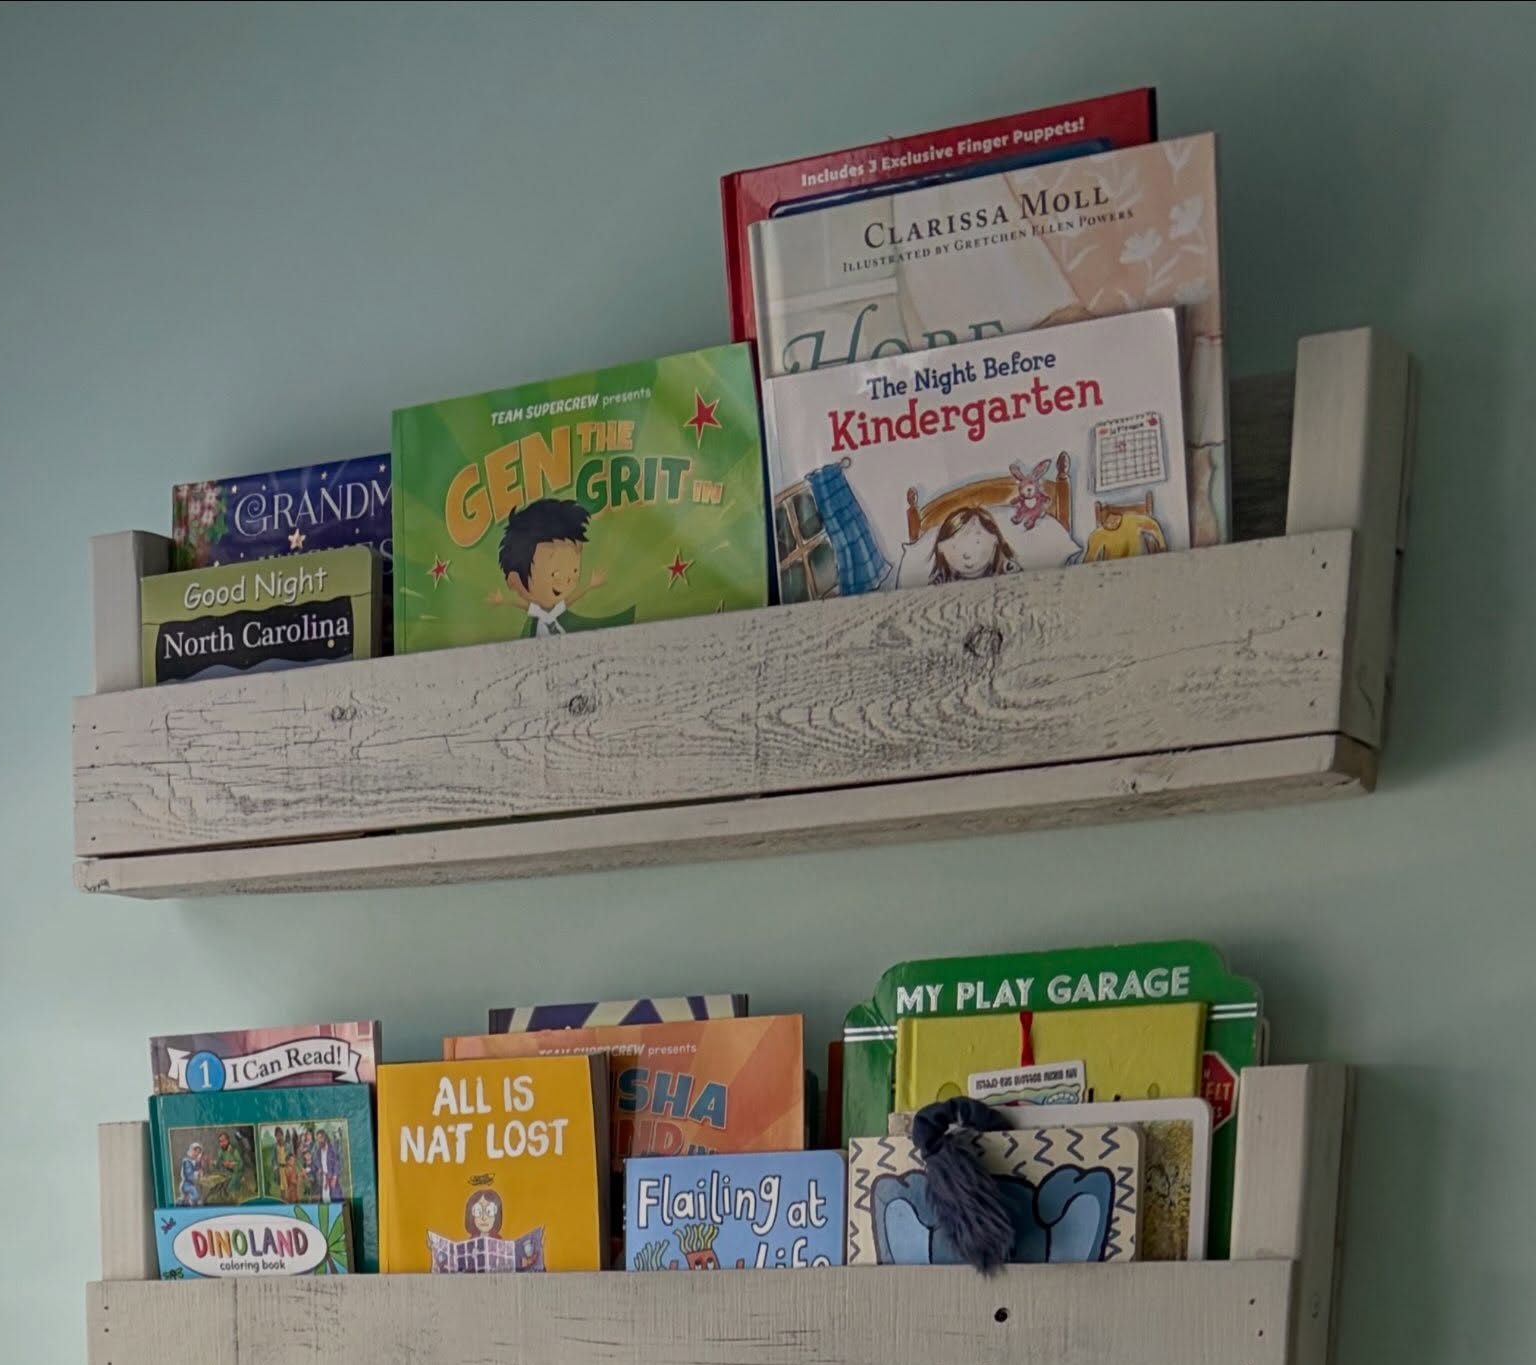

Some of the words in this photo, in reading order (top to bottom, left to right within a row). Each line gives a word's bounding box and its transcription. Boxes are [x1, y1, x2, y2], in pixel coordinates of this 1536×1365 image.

[801, 165, 864, 187] Includes
[869, 161, 877, 175] 3
[881, 146, 953, 171] Exclusive
[957, 135, 1009, 156] Finger
[1012, 117, 1085, 145] Puppets!
[842, 247, 931, 273] ILLUSTRATED
[954, 228, 1026, 251] GRETCHEN
[1031, 220, 1074, 238] ELLEN
[1078, 208, 1134, 227] POWERS
[864, 205, 1009, 248] CLARISSA
[1020, 186, 1109, 219] MOLL
[866, 374, 908, 401] The
[914, 360, 977, 395] Night
[983, 350, 1056, 380] Before
[491, 410, 524, 426] TEAM
[525, 392, 600, 420] SUPERCREW
[602, 387, 652, 408] presents
[828, 376, 1103, 453] Kindergarten
[445, 425, 573, 548] GEN
[576, 420, 636, 454] THE
[575, 455, 693, 518] GRIT
[692, 480, 724, 505] IN
[183, 576, 246, 609] Good
[254, 566, 328, 604] Night
[163, 625, 235, 660] North
[242, 614, 350, 649] Carolina
[896, 983, 944, 1015] MY
[956, 977, 1035, 1011] PLAY
[1046, 965, 1191, 1005] GARAGE
[199, 1060, 212, 1088] 1
[231, 1064, 240, 1083] I
[243, 1058, 282, 1081] Can
[286, 1044, 342, 1069] Read!
[648, 1042, 697, 1057] presents
[432, 1076, 492, 1117] ALL
[503, 1075, 536, 1113] IS
[399, 1123, 474, 1165] NAT
[486, 1118, 569, 1160] LOST
[636, 1170, 781, 1235] Flailing
[787, 1179, 829, 1229] at
[191, 1227, 308, 1259] DINOLAND
[219, 1258, 260, 1273] coloring
[262, 1258, 286, 1271] book
